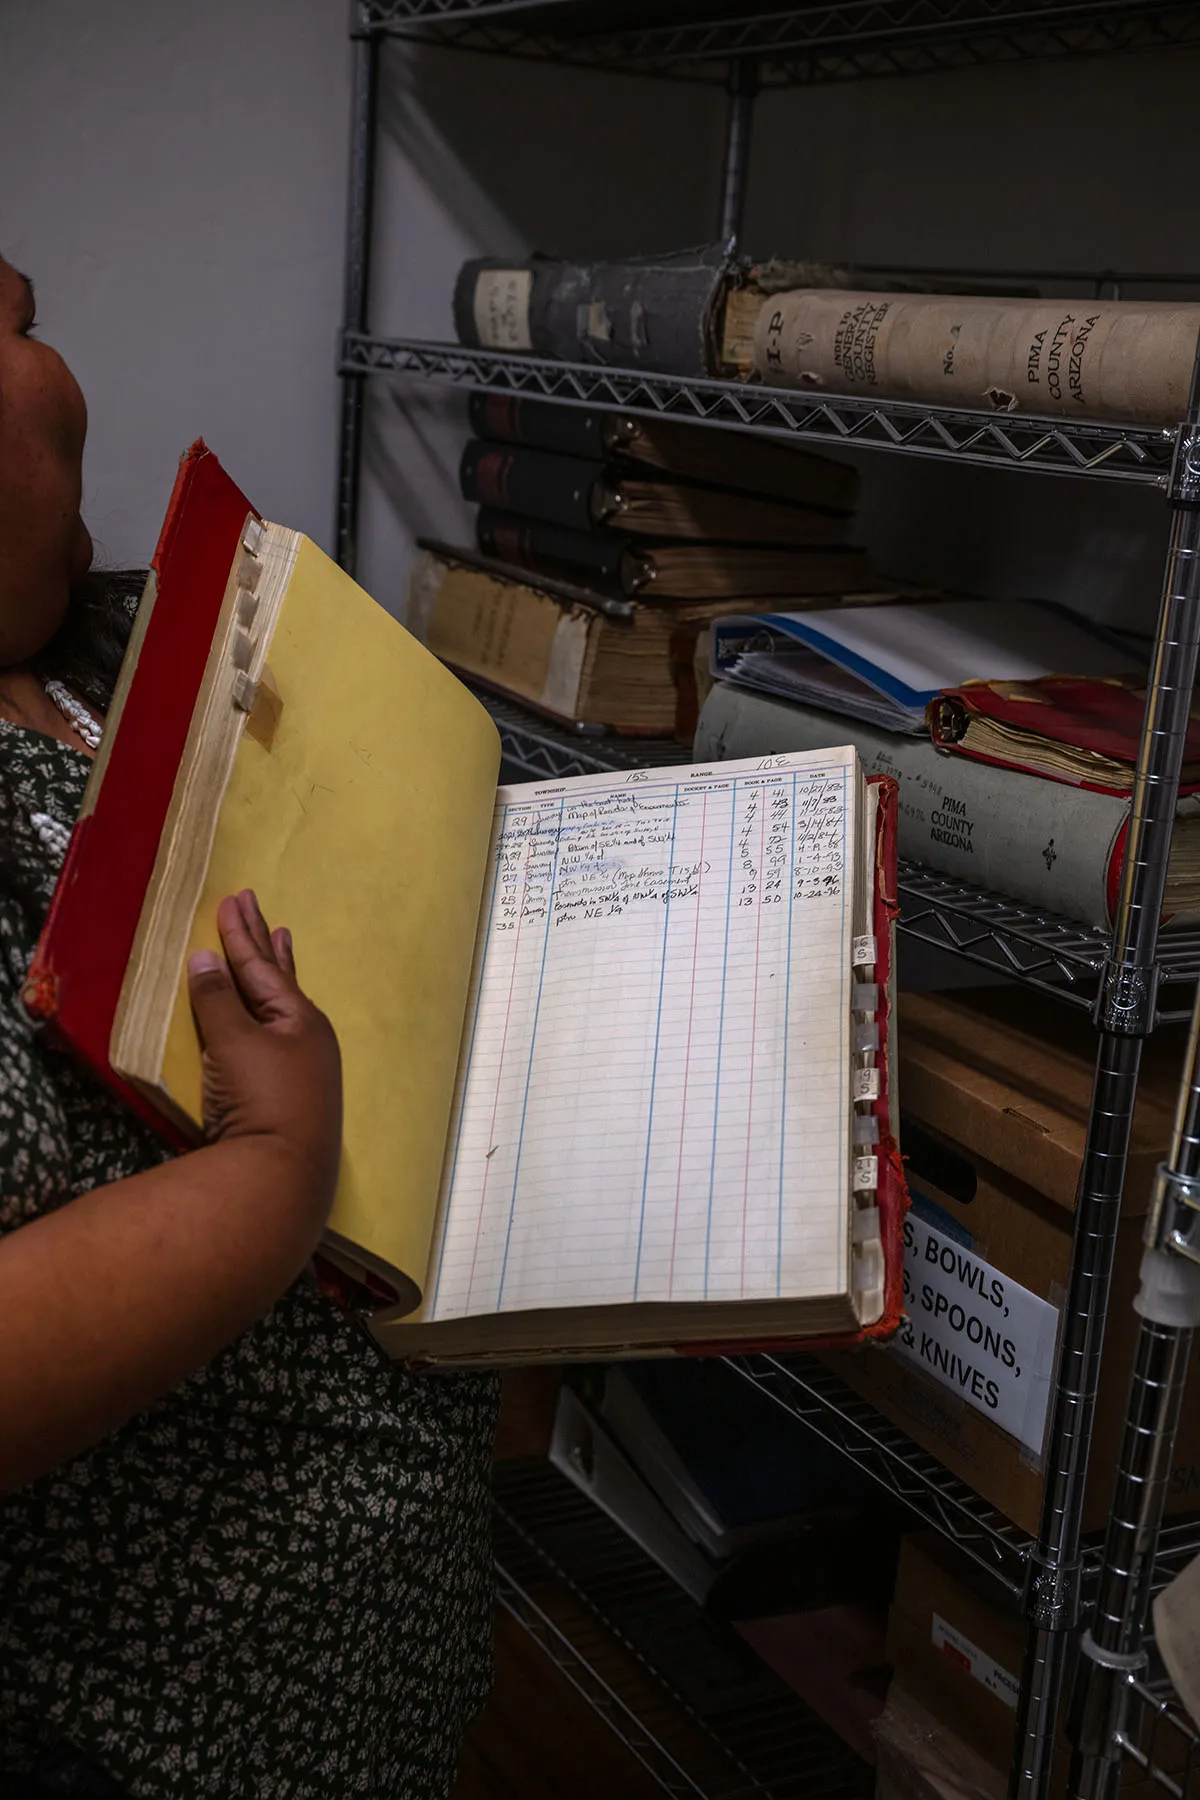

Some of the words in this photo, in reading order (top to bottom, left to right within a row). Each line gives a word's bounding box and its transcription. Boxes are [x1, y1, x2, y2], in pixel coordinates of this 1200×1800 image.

[834, 330, 844, 366] INDEX
[843, 301, 870, 381] GENERAL
[853, 304, 877, 381] COUNTY
[864, 302, 890, 386] REGISTER
[1027, 330, 1048, 384] PIMA
[1048, 314, 1075, 400] COUNTY
[1068, 314, 1100, 404] ARIZONA
[534, 788, 566, 796] TOWNSHIP
[942, 796, 966, 816] PIMA
[568, 811, 589, 820] Map
[931, 811, 974, 836] COUNTY
[740, 848, 750, 858] 5
[766, 844, 784, 854] 55
[930, 828, 974, 853] ARIZONA
[742, 860, 752, 870] 8
[584, 908, 602, 918] NE
[738, 898, 753, 906] 13
[762, 894, 782, 904] 50
[742, 884, 756, 894] 13
[924, 1236, 1009, 1317] BOWLS,
[920, 1284, 1021, 1378] SPOONS,
[920, 1332, 1000, 1409] KNIVES
